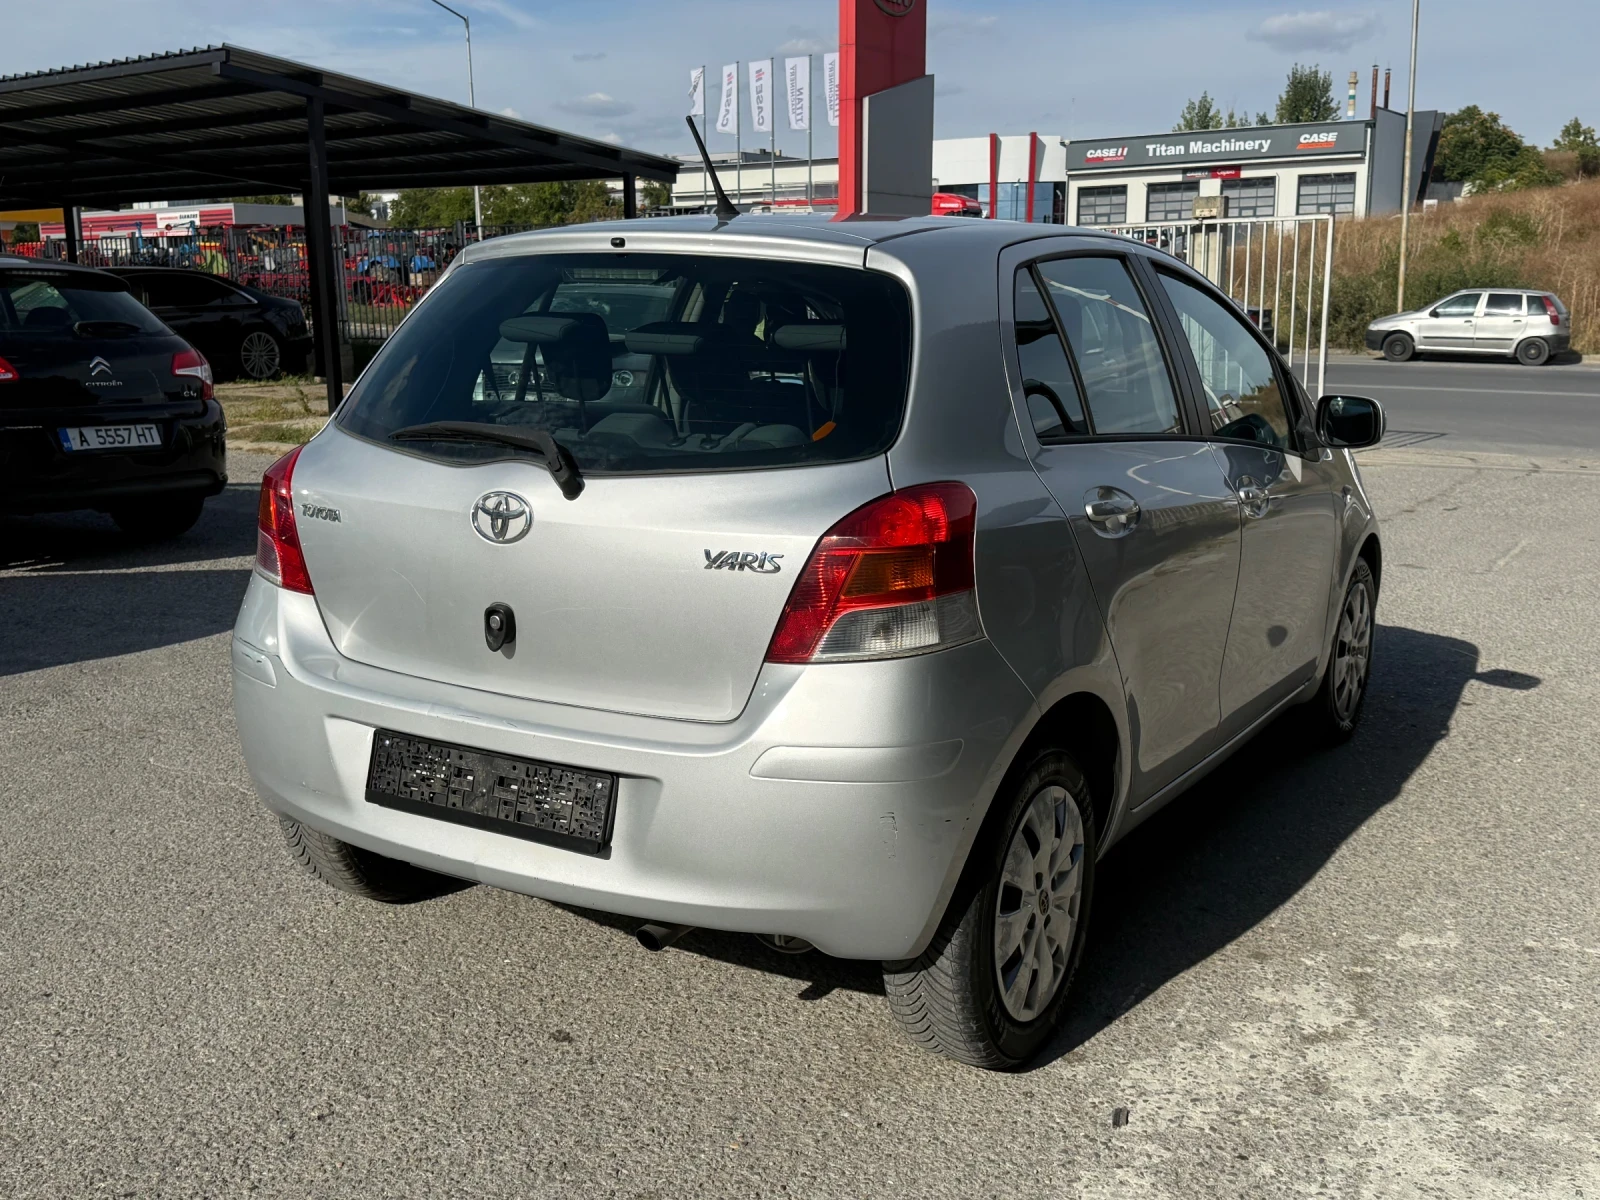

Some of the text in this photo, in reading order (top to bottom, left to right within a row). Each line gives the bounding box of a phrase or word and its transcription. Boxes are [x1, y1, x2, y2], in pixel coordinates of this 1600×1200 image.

[1145, 138, 1271, 157] Titan Machinery
[1299, 132, 1338, 144] CASE
[79, 429, 91, 447] A
[95, 427, 132, 445] 5557
[135, 427, 155, 444] HT
[301, 503, 342, 523] TOYOTA
